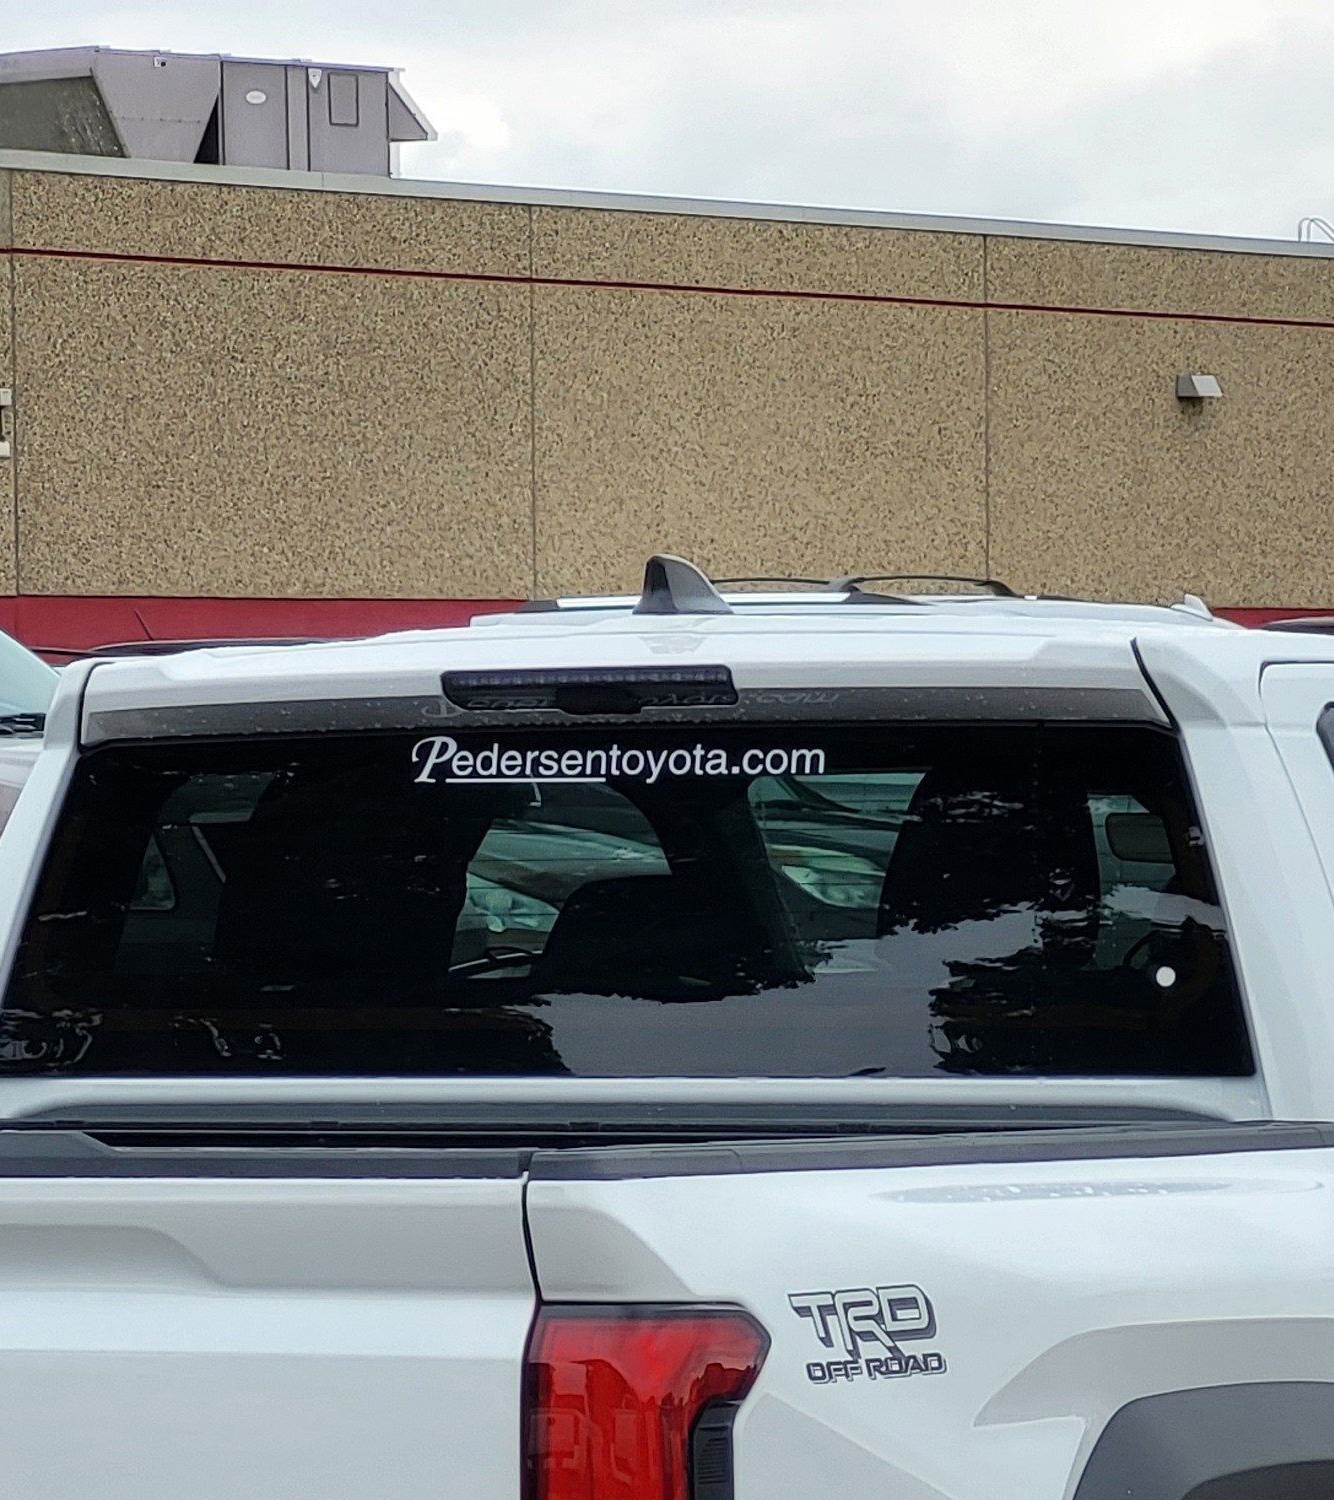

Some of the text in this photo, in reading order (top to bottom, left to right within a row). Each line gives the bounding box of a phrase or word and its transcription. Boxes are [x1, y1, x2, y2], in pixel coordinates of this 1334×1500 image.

[411, 735, 826, 784] Pedersentoyota.com
[787, 1284, 937, 1360] TRD
[806, 1352, 947, 1384] OFF ROAD
